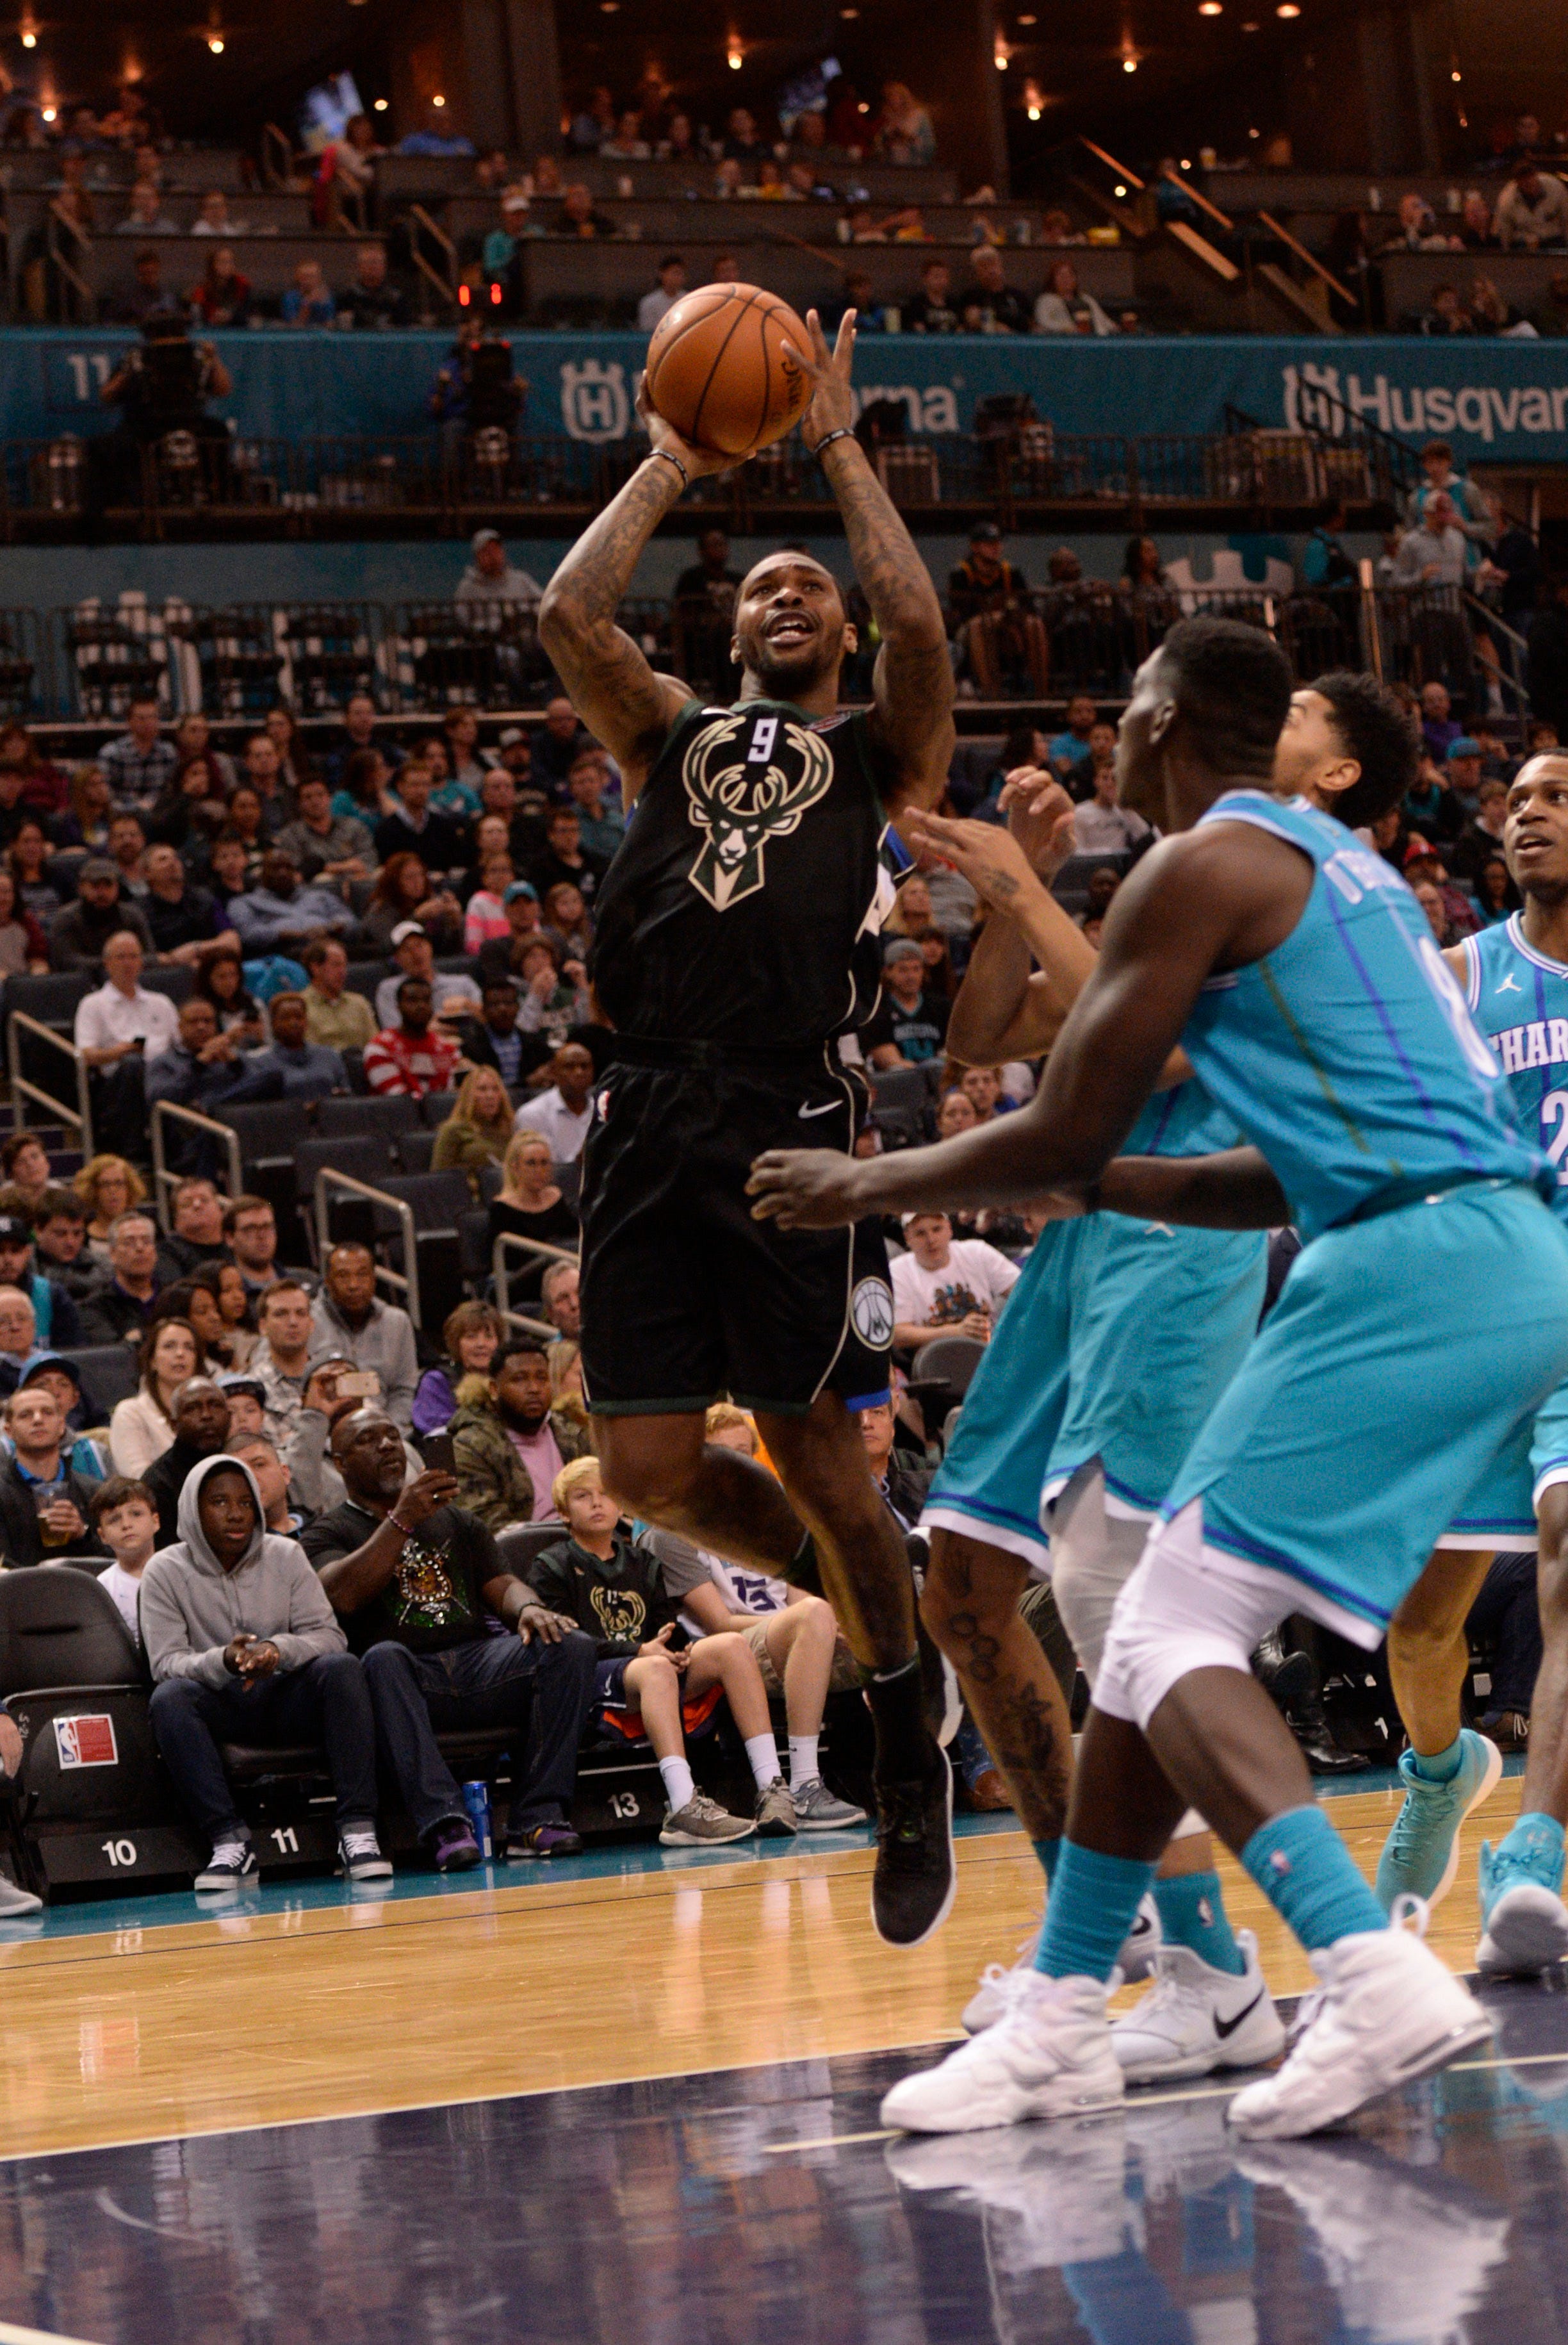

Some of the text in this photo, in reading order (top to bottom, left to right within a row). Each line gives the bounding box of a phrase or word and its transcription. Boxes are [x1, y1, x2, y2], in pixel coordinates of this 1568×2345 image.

[747, 718, 778, 762] 9
[731, 1576, 777, 1611] 15
[608, 1793, 640, 1818] 13
[101, 1839, 137, 1866] 10
[270, 1827, 299, 1854] 11
